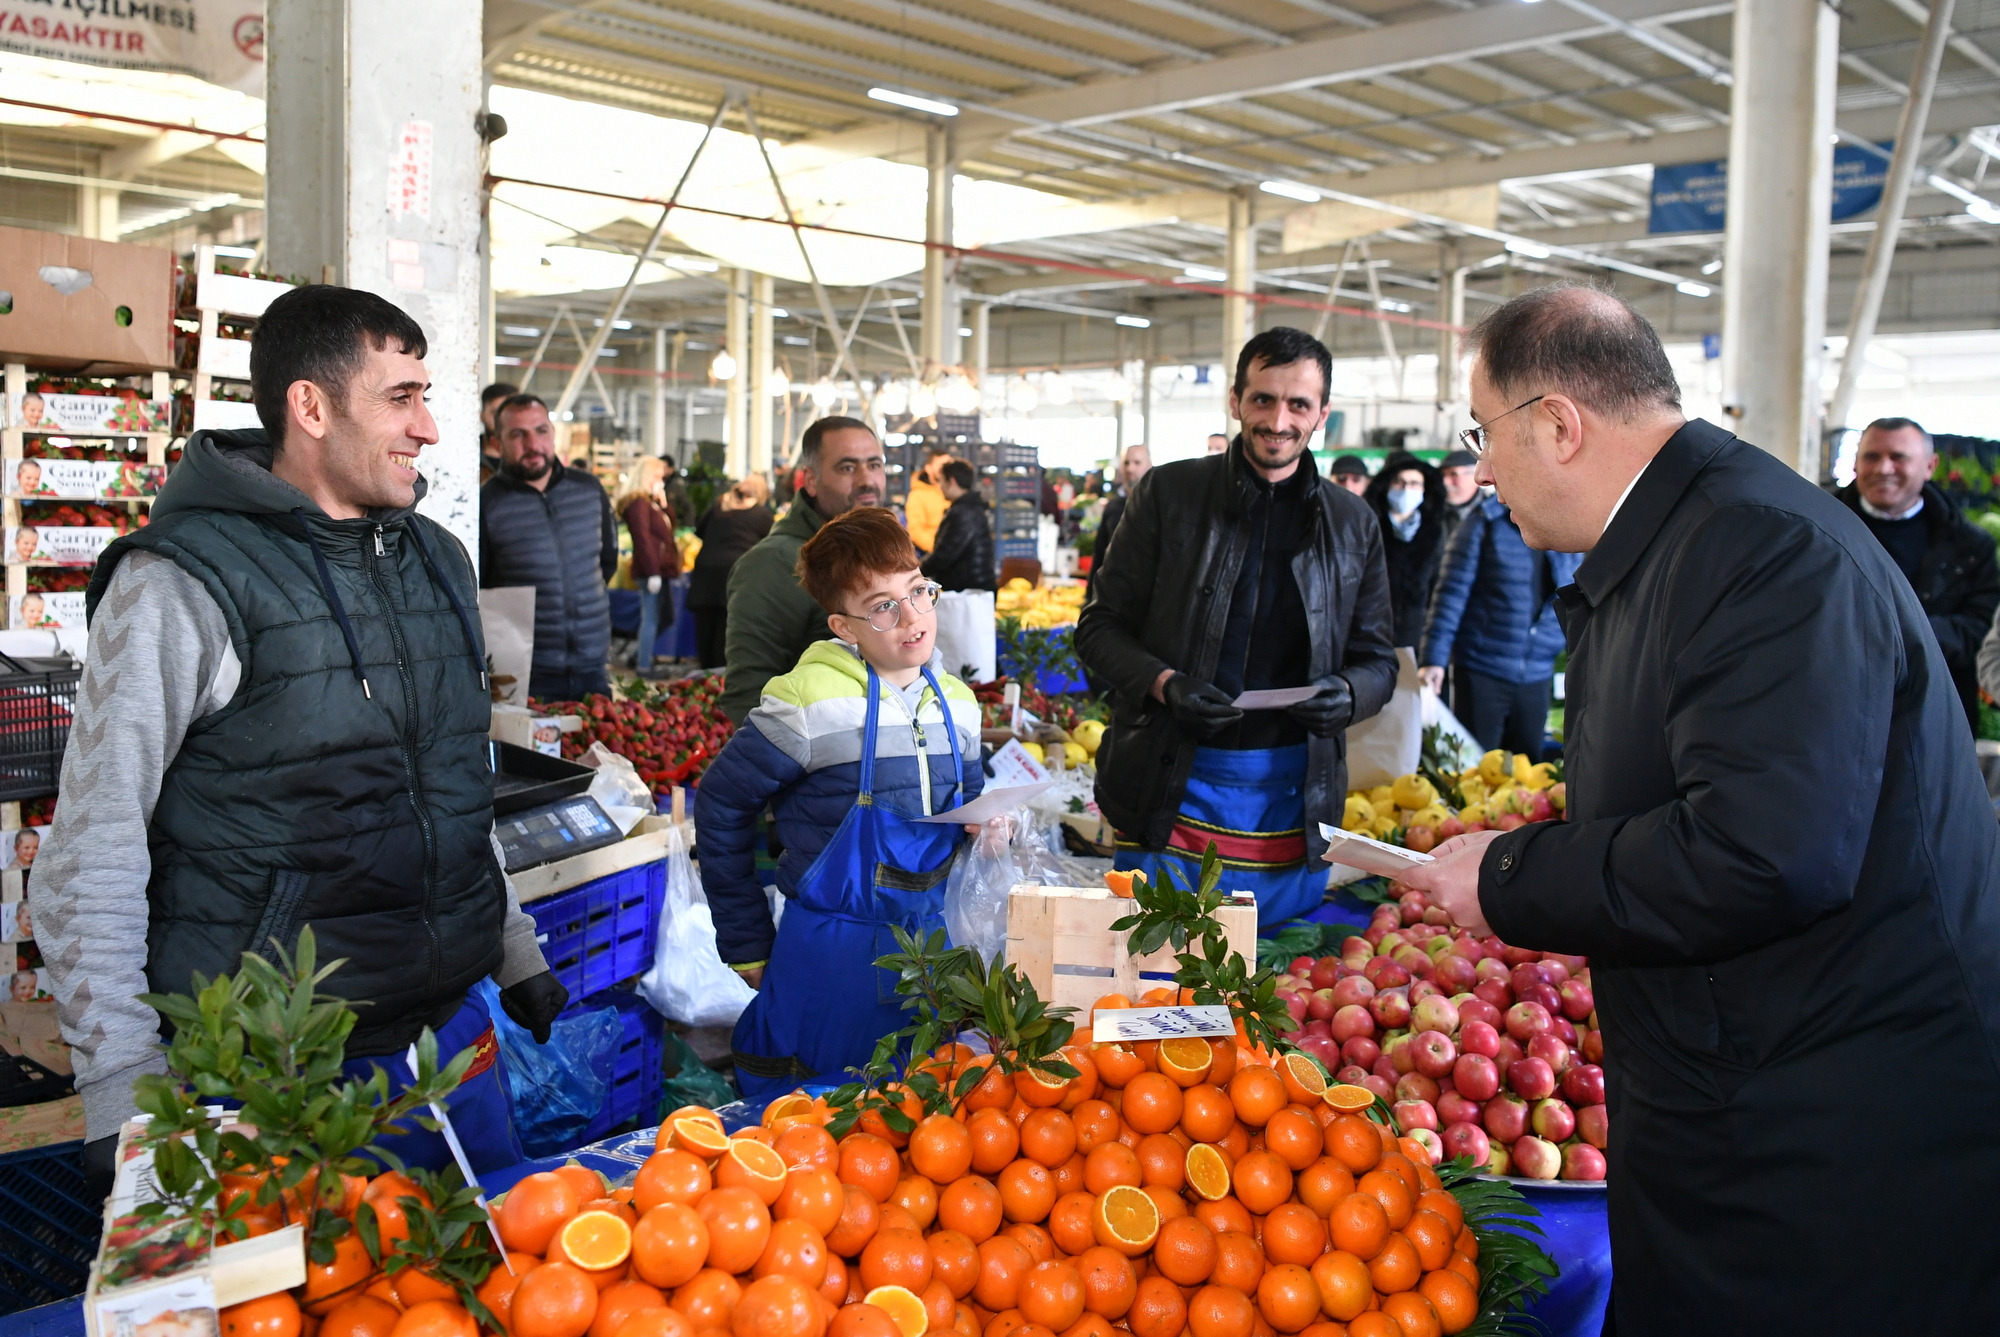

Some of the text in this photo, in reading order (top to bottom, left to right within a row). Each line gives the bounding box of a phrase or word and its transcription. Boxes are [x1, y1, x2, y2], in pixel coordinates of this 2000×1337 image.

[50, 397, 108, 415] Garip
[48, 463, 107, 481] Garip
[44, 529, 102, 547] Garip
